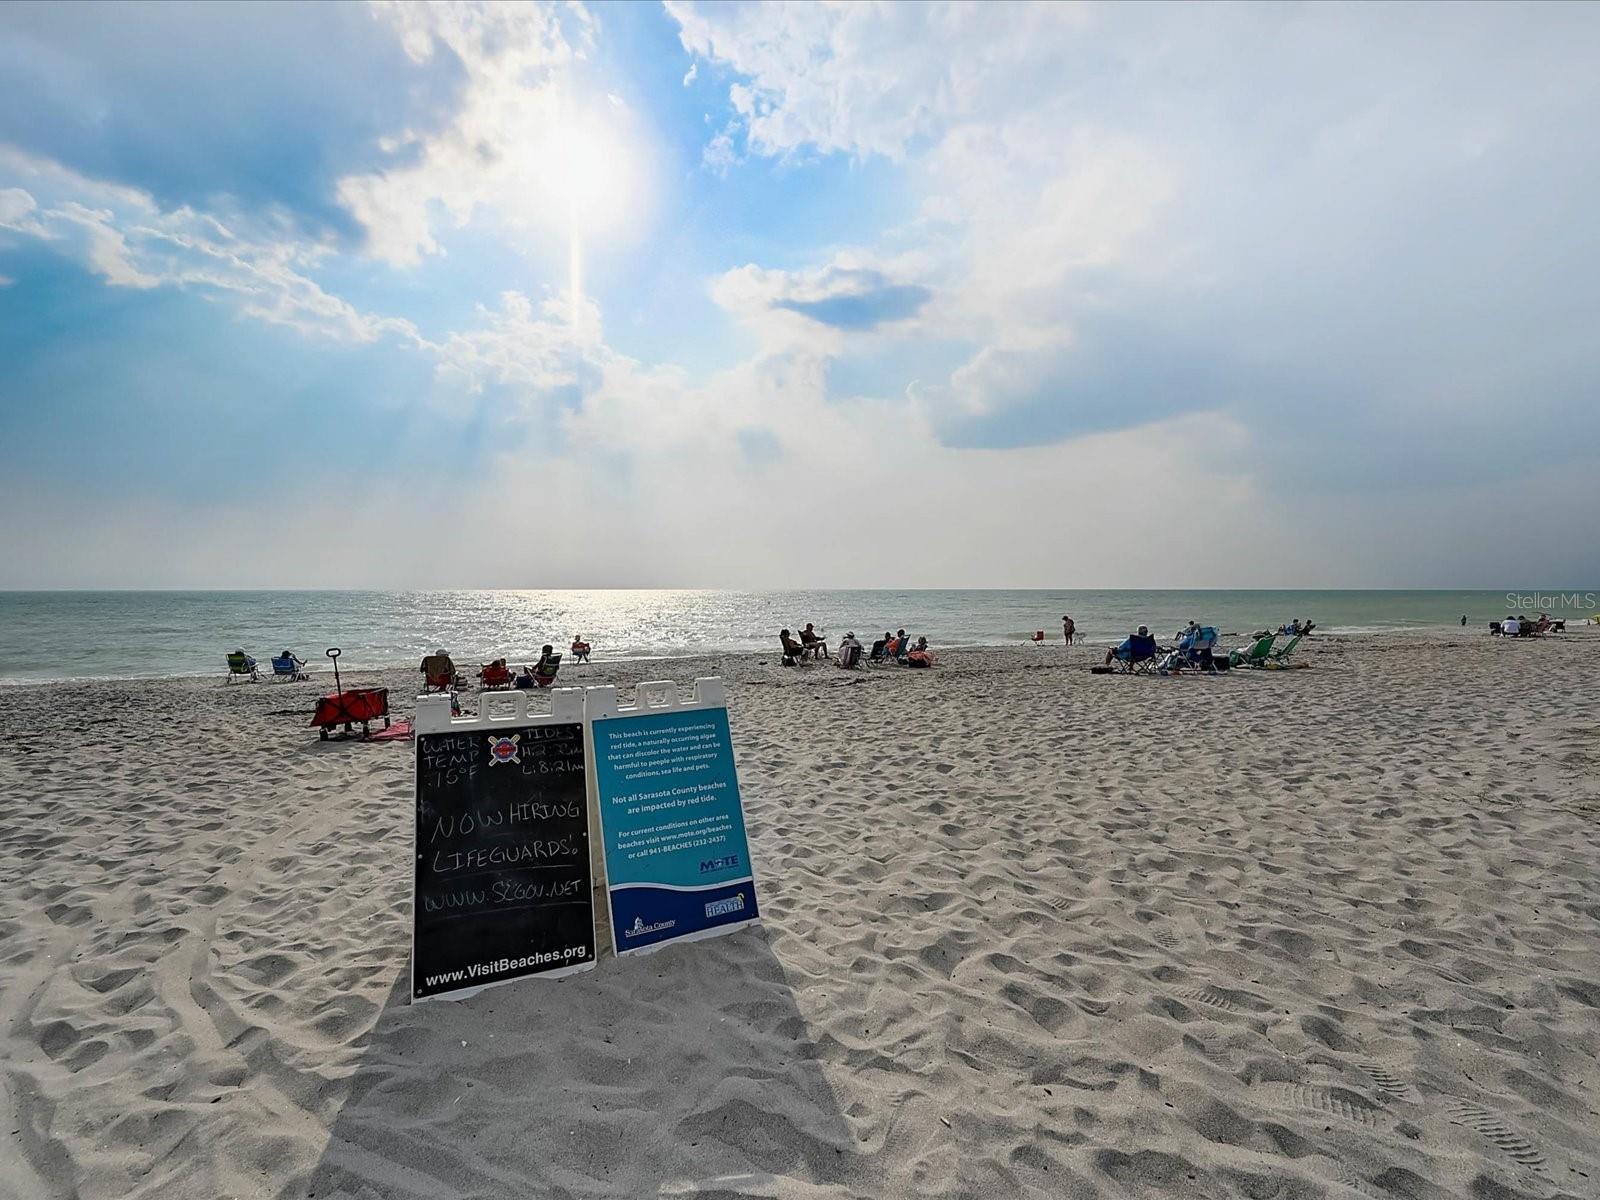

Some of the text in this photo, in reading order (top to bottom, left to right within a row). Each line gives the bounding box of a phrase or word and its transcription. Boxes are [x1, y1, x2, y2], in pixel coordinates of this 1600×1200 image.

[523, 727, 574, 740] TIDES
[678, 723, 715, 732] experiencing
[423, 736, 480, 753] WATER
[671, 735, 699, 743] occurring
[423, 750, 480, 768] TEMP
[635, 750, 659, 758] discolor
[649, 758, 669, 767] people
[686, 753, 717, 761] respiratory
[626, 770, 660, 780] conditions,
[639, 790, 670, 800] Sarasota
[672, 785, 697, 795] County
[698, 782, 726, 791] beaches
[641, 800, 675, 812] impacted
[677, 799, 686, 807] by
[431, 800, 580, 843] NOW HIRING
[631, 827, 654, 836] current
[656, 822, 688, 831] conditions
[618, 840, 645, 849] beaches
[661, 824, 732, 842] www.mote.org/beaches
[432, 834, 578, 872] LIFEGUARDS!
[649, 842, 692, 856] 941-BEACHES
[426, 946, 586, 986] www.VisitBeaches.org
